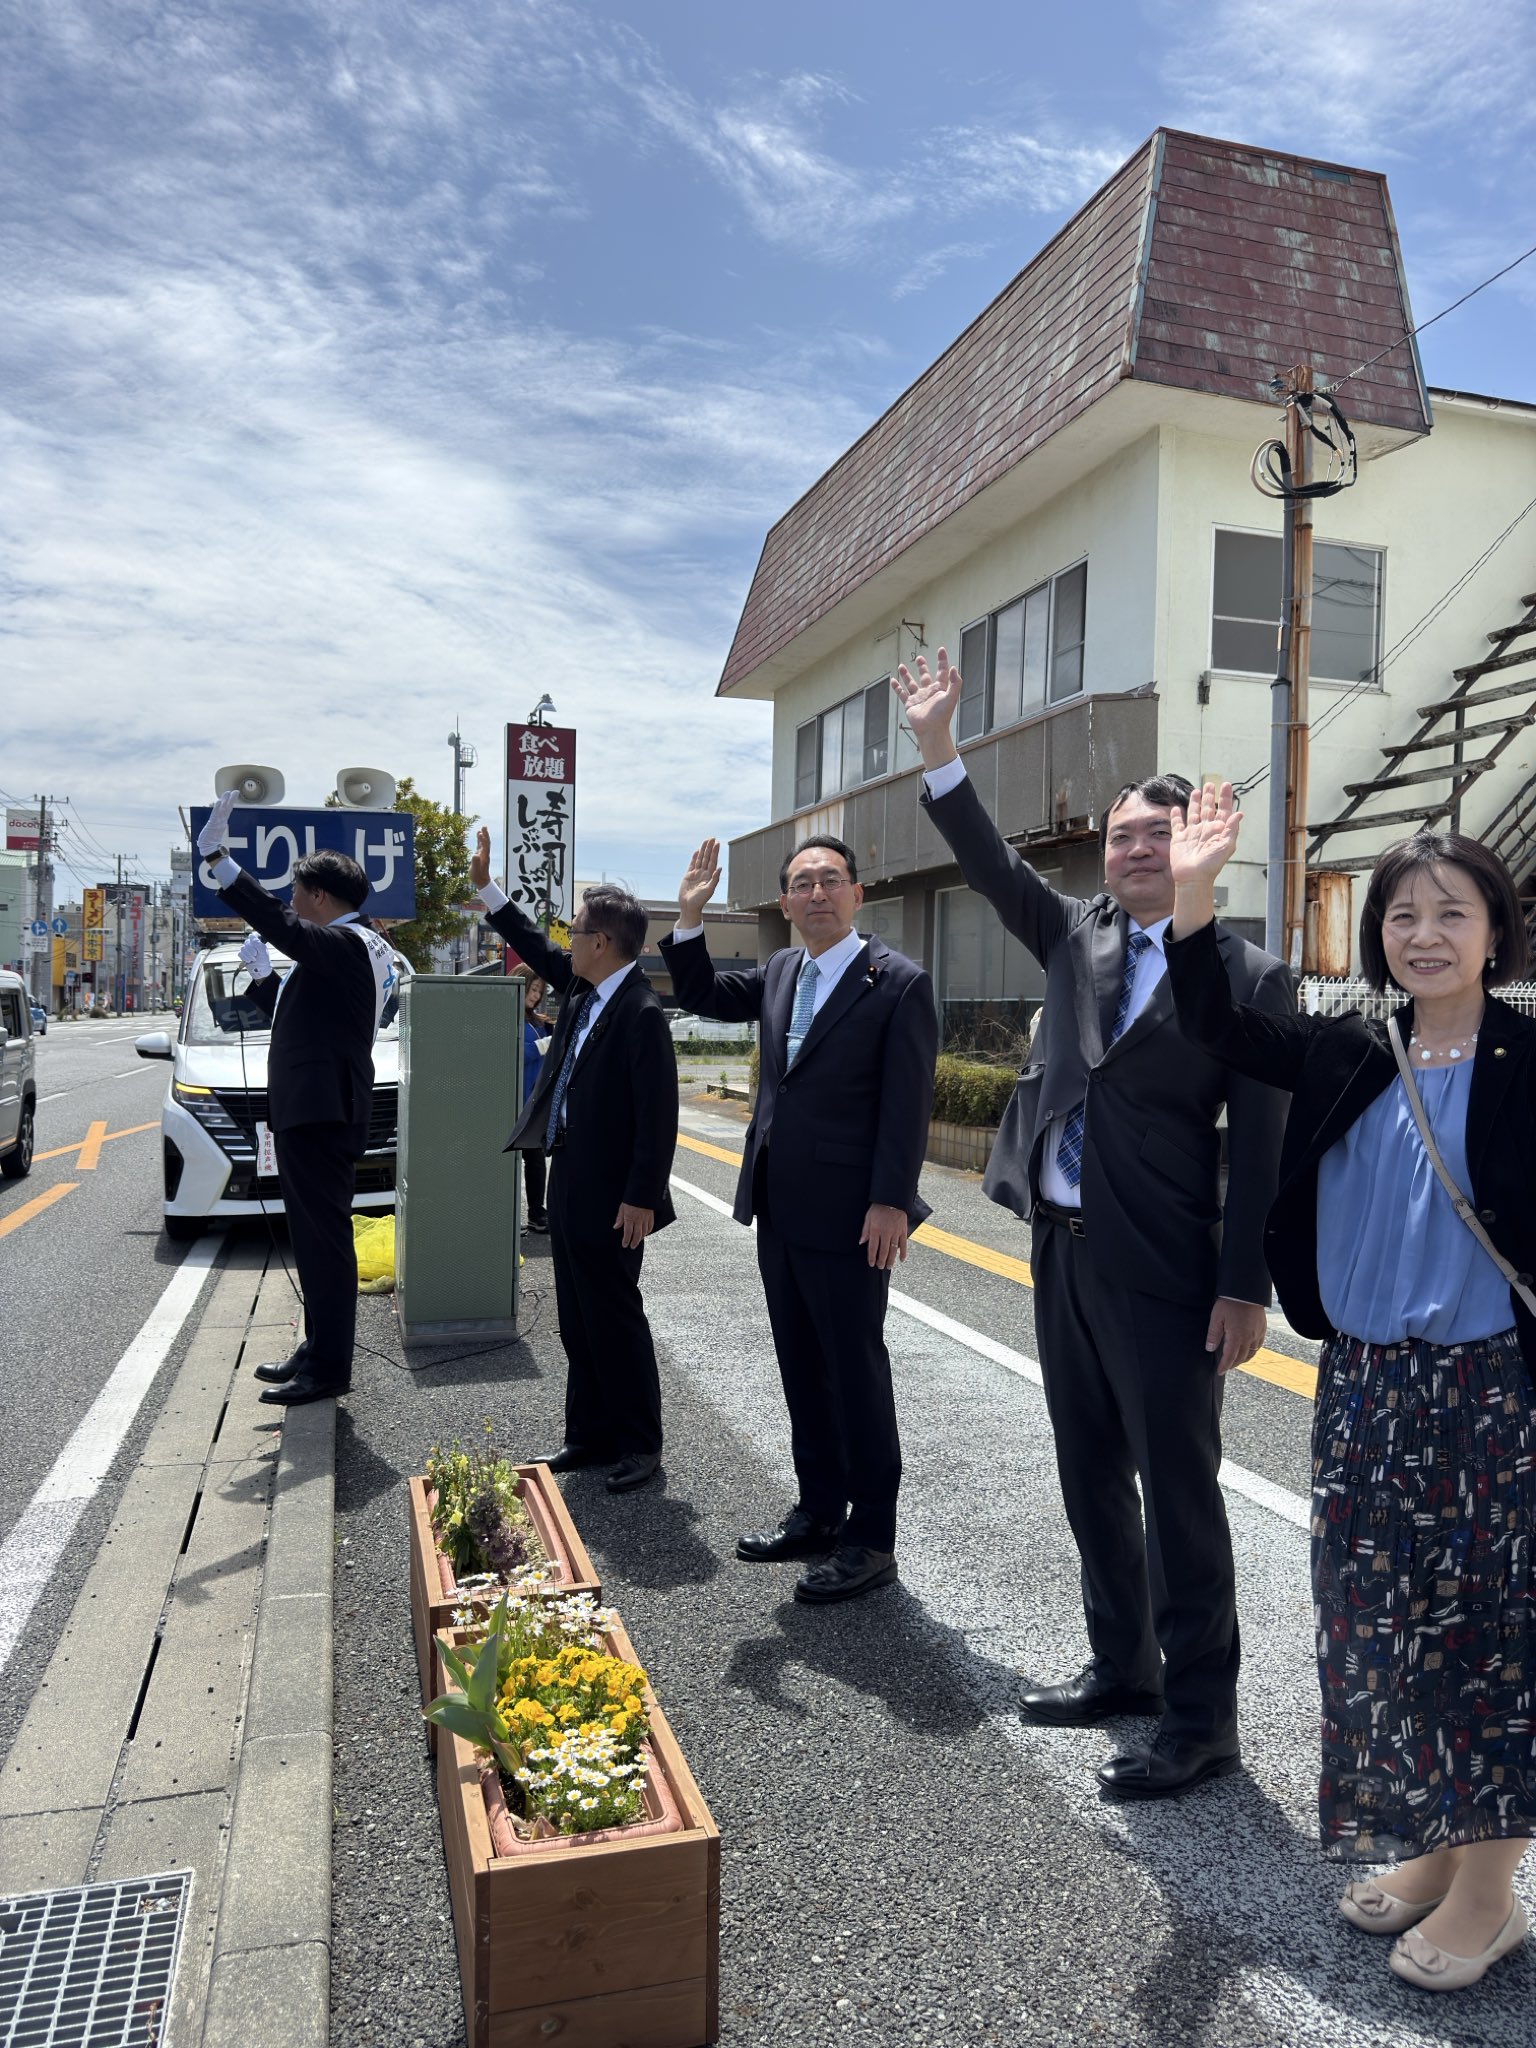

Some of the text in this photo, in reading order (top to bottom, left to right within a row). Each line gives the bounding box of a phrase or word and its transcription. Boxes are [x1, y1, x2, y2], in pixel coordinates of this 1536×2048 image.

[518, 730, 560, 755] 食べ
[523, 755, 565, 780] 放題
[510, 793, 548, 904] しゃぶしゃぶ
[535, 786, 570, 887] 寿司
